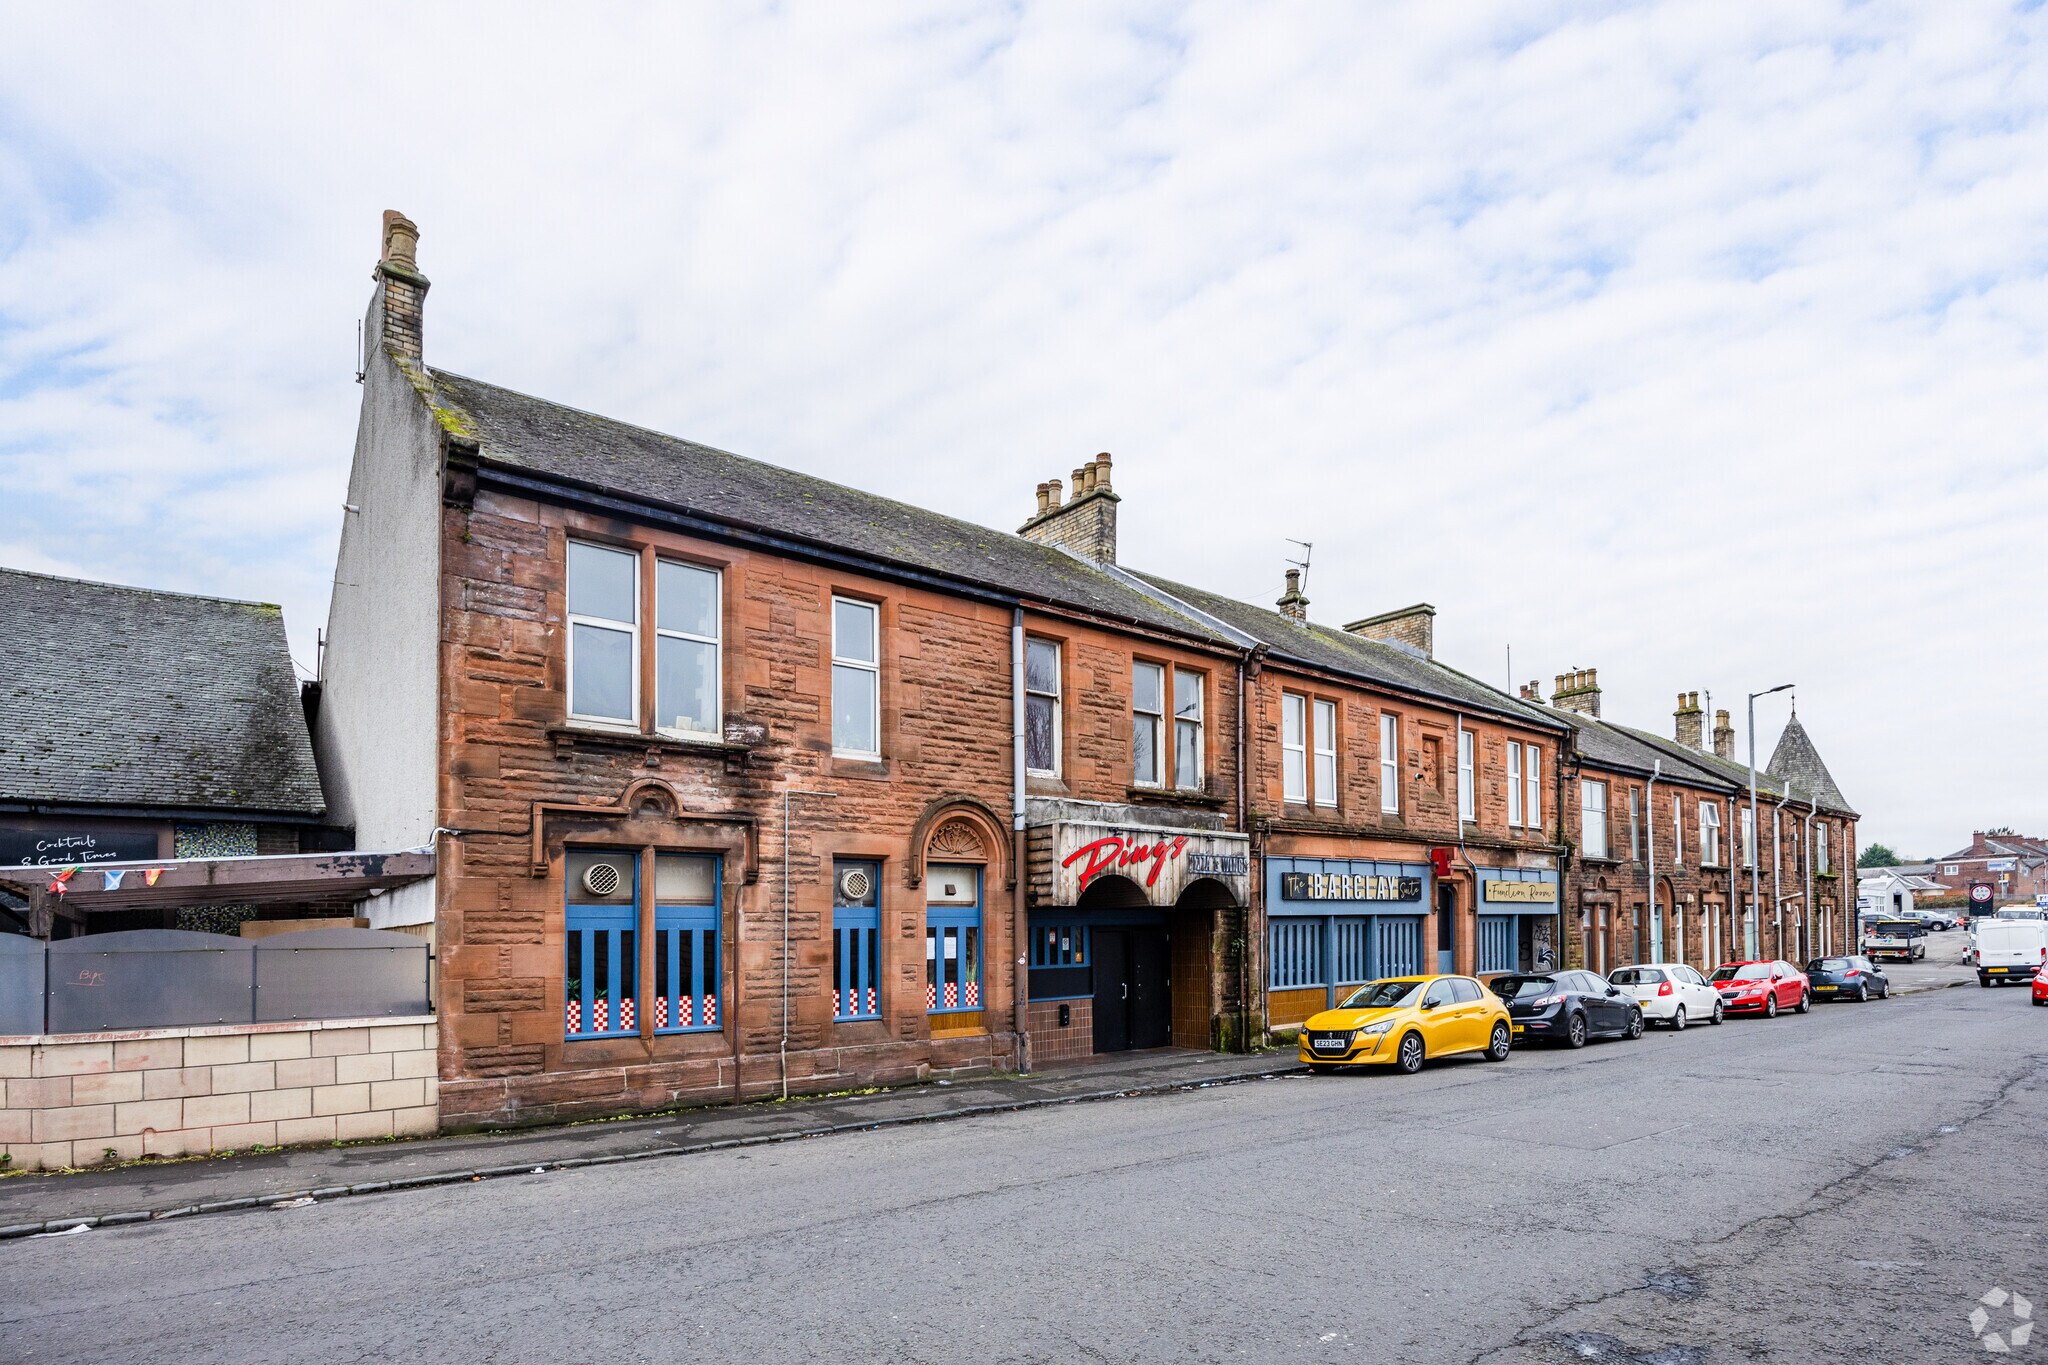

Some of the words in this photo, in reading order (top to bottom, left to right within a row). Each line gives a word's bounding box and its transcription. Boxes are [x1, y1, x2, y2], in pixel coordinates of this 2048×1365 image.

[36, 834, 97, 851] Cocktails
[37, 852, 75, 866] Good
[79, 851, 117, 863] Times
[1221, 856, 1248, 873] WINGS
[1287, 875, 1305, 897] The
[1314, 873, 1396, 900] BARCLAY
[1399, 880, 1420, 899] Suite
[1491, 881, 1526, 899] Function
[1528, 884, 1552, 900] Room
